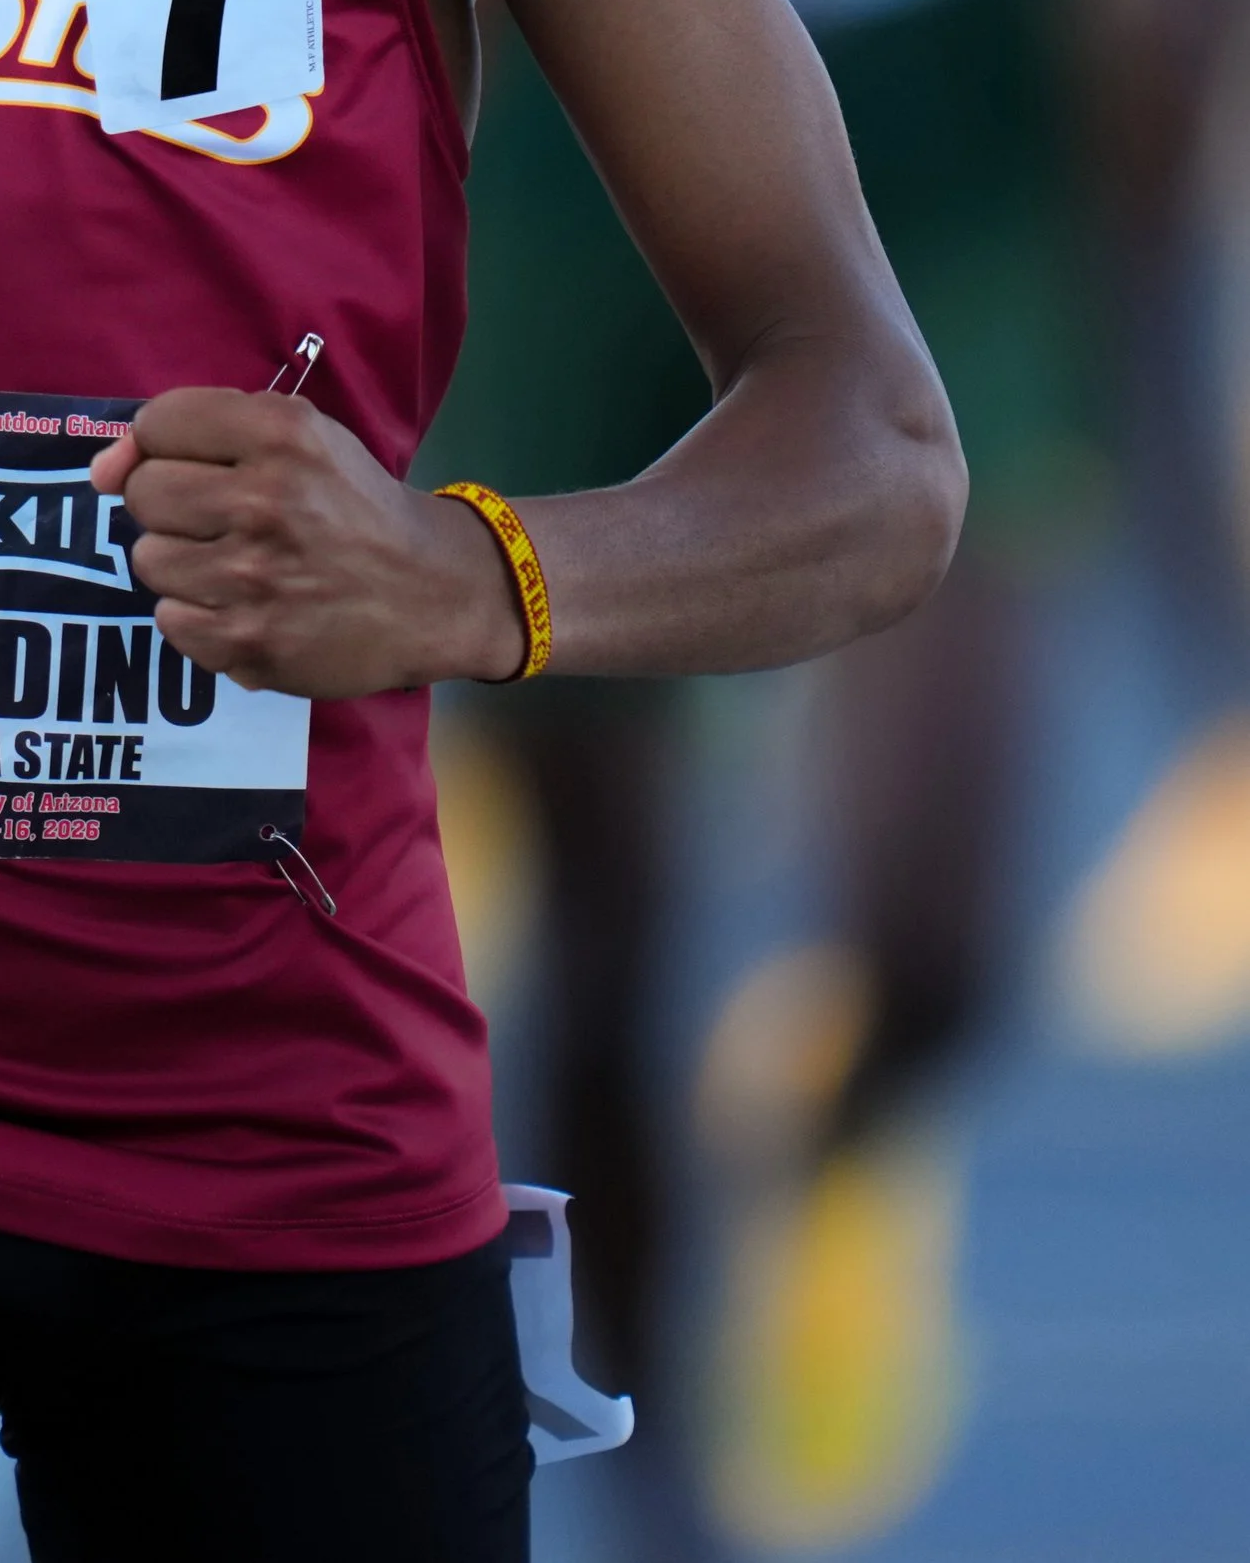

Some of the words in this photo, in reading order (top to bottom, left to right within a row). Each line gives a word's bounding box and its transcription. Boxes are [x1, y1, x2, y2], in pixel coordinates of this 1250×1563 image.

[305, 0, 316, 51] ATHLETIC
[66, 414, 134, 438] Cham
[13, 730, 145, 781] STATE
[11, 791, 36, 813] of
[38, 792, 121, 814] Arizona
[42, 819, 100, 840] 2026
